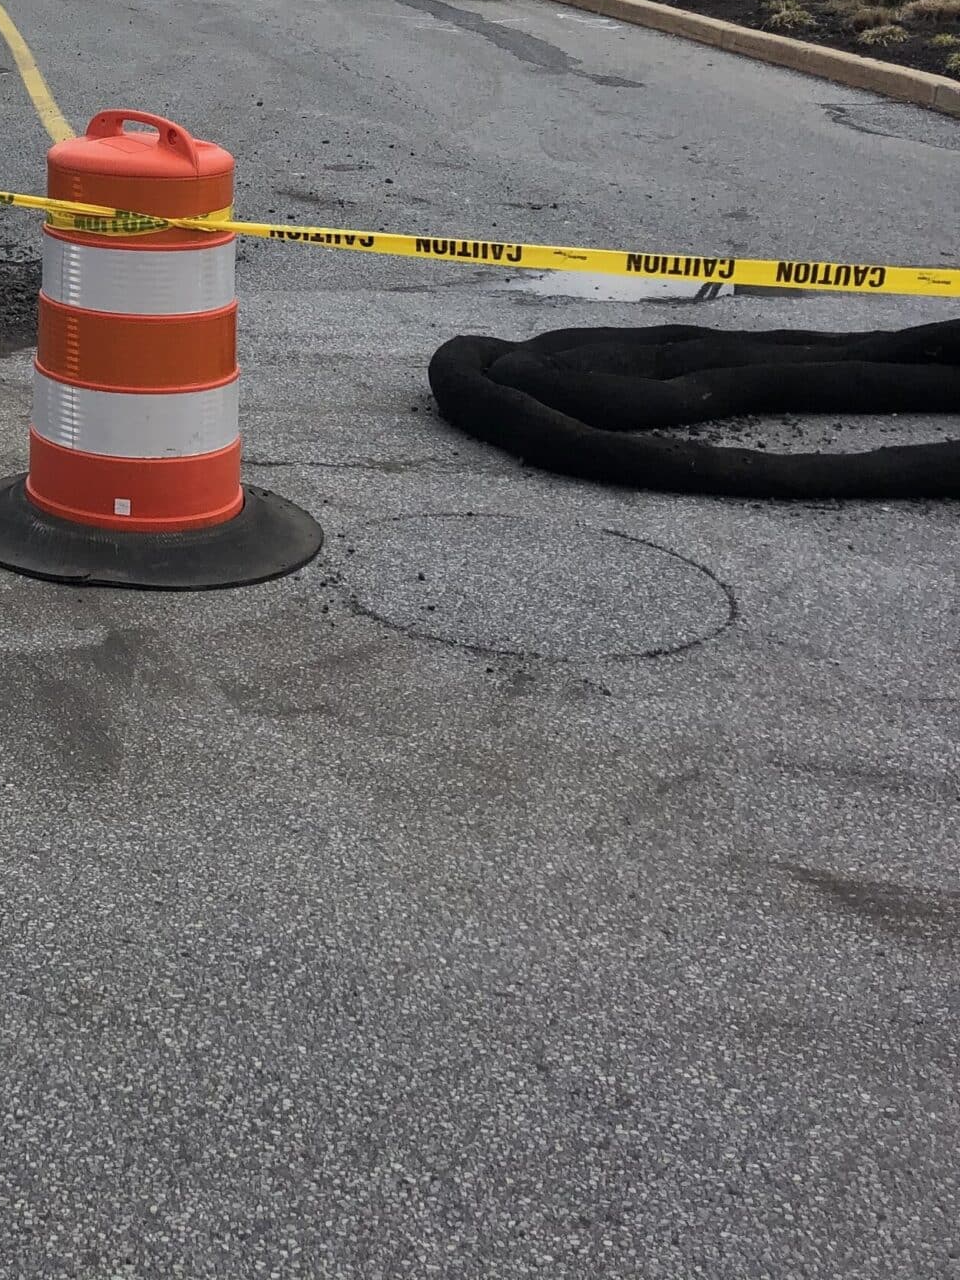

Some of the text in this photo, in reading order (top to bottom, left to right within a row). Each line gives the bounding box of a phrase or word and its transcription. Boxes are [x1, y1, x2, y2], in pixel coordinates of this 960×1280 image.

[416, 238, 522, 262] CAUTION
[626, 253, 735, 279] CAUTION
[776, 262, 886, 287] CAUTION
